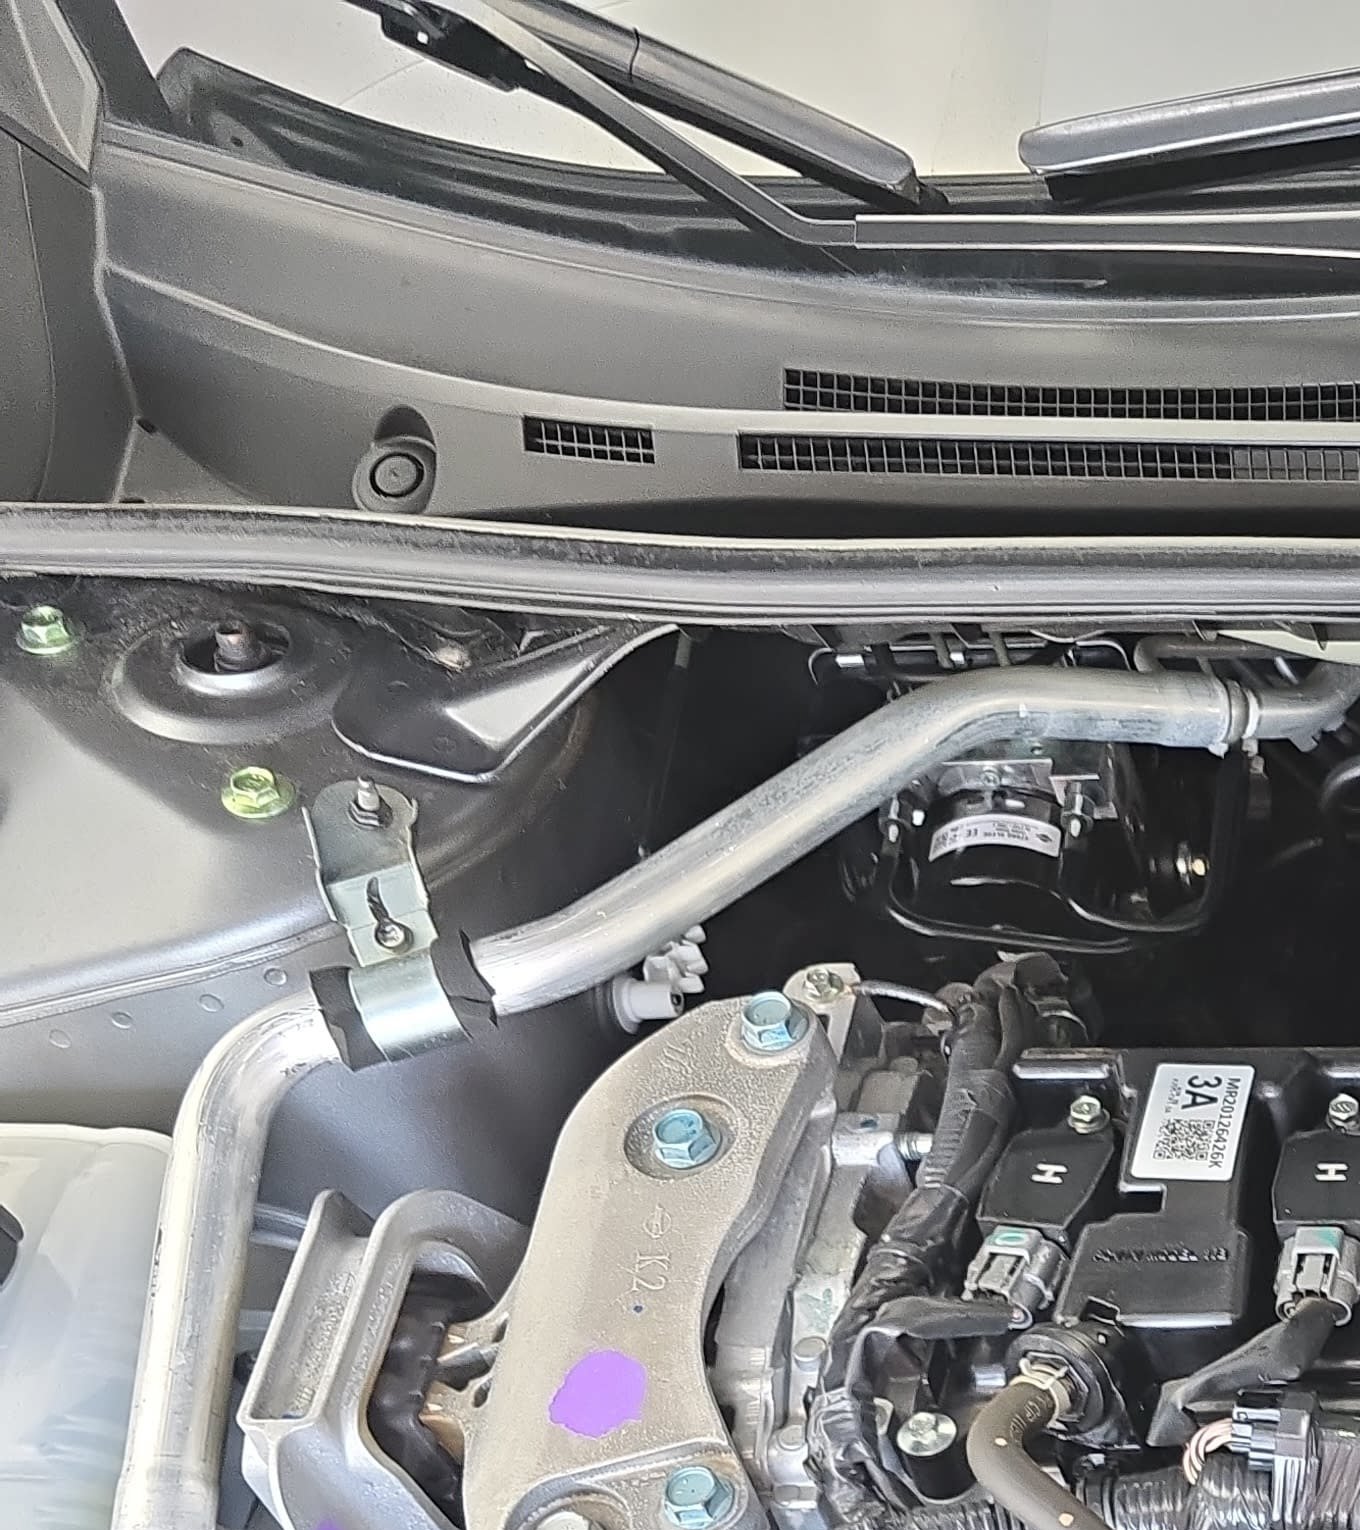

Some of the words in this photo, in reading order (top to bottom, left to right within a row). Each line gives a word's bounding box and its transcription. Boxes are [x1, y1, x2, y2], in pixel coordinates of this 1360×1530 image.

[1181, 1075, 1222, 1110] 3A
[1208, 1078, 1241, 1168] MR20126426K
[1031, 1163, 1069, 1184] H
[1315, 1162, 1349, 1181] H
